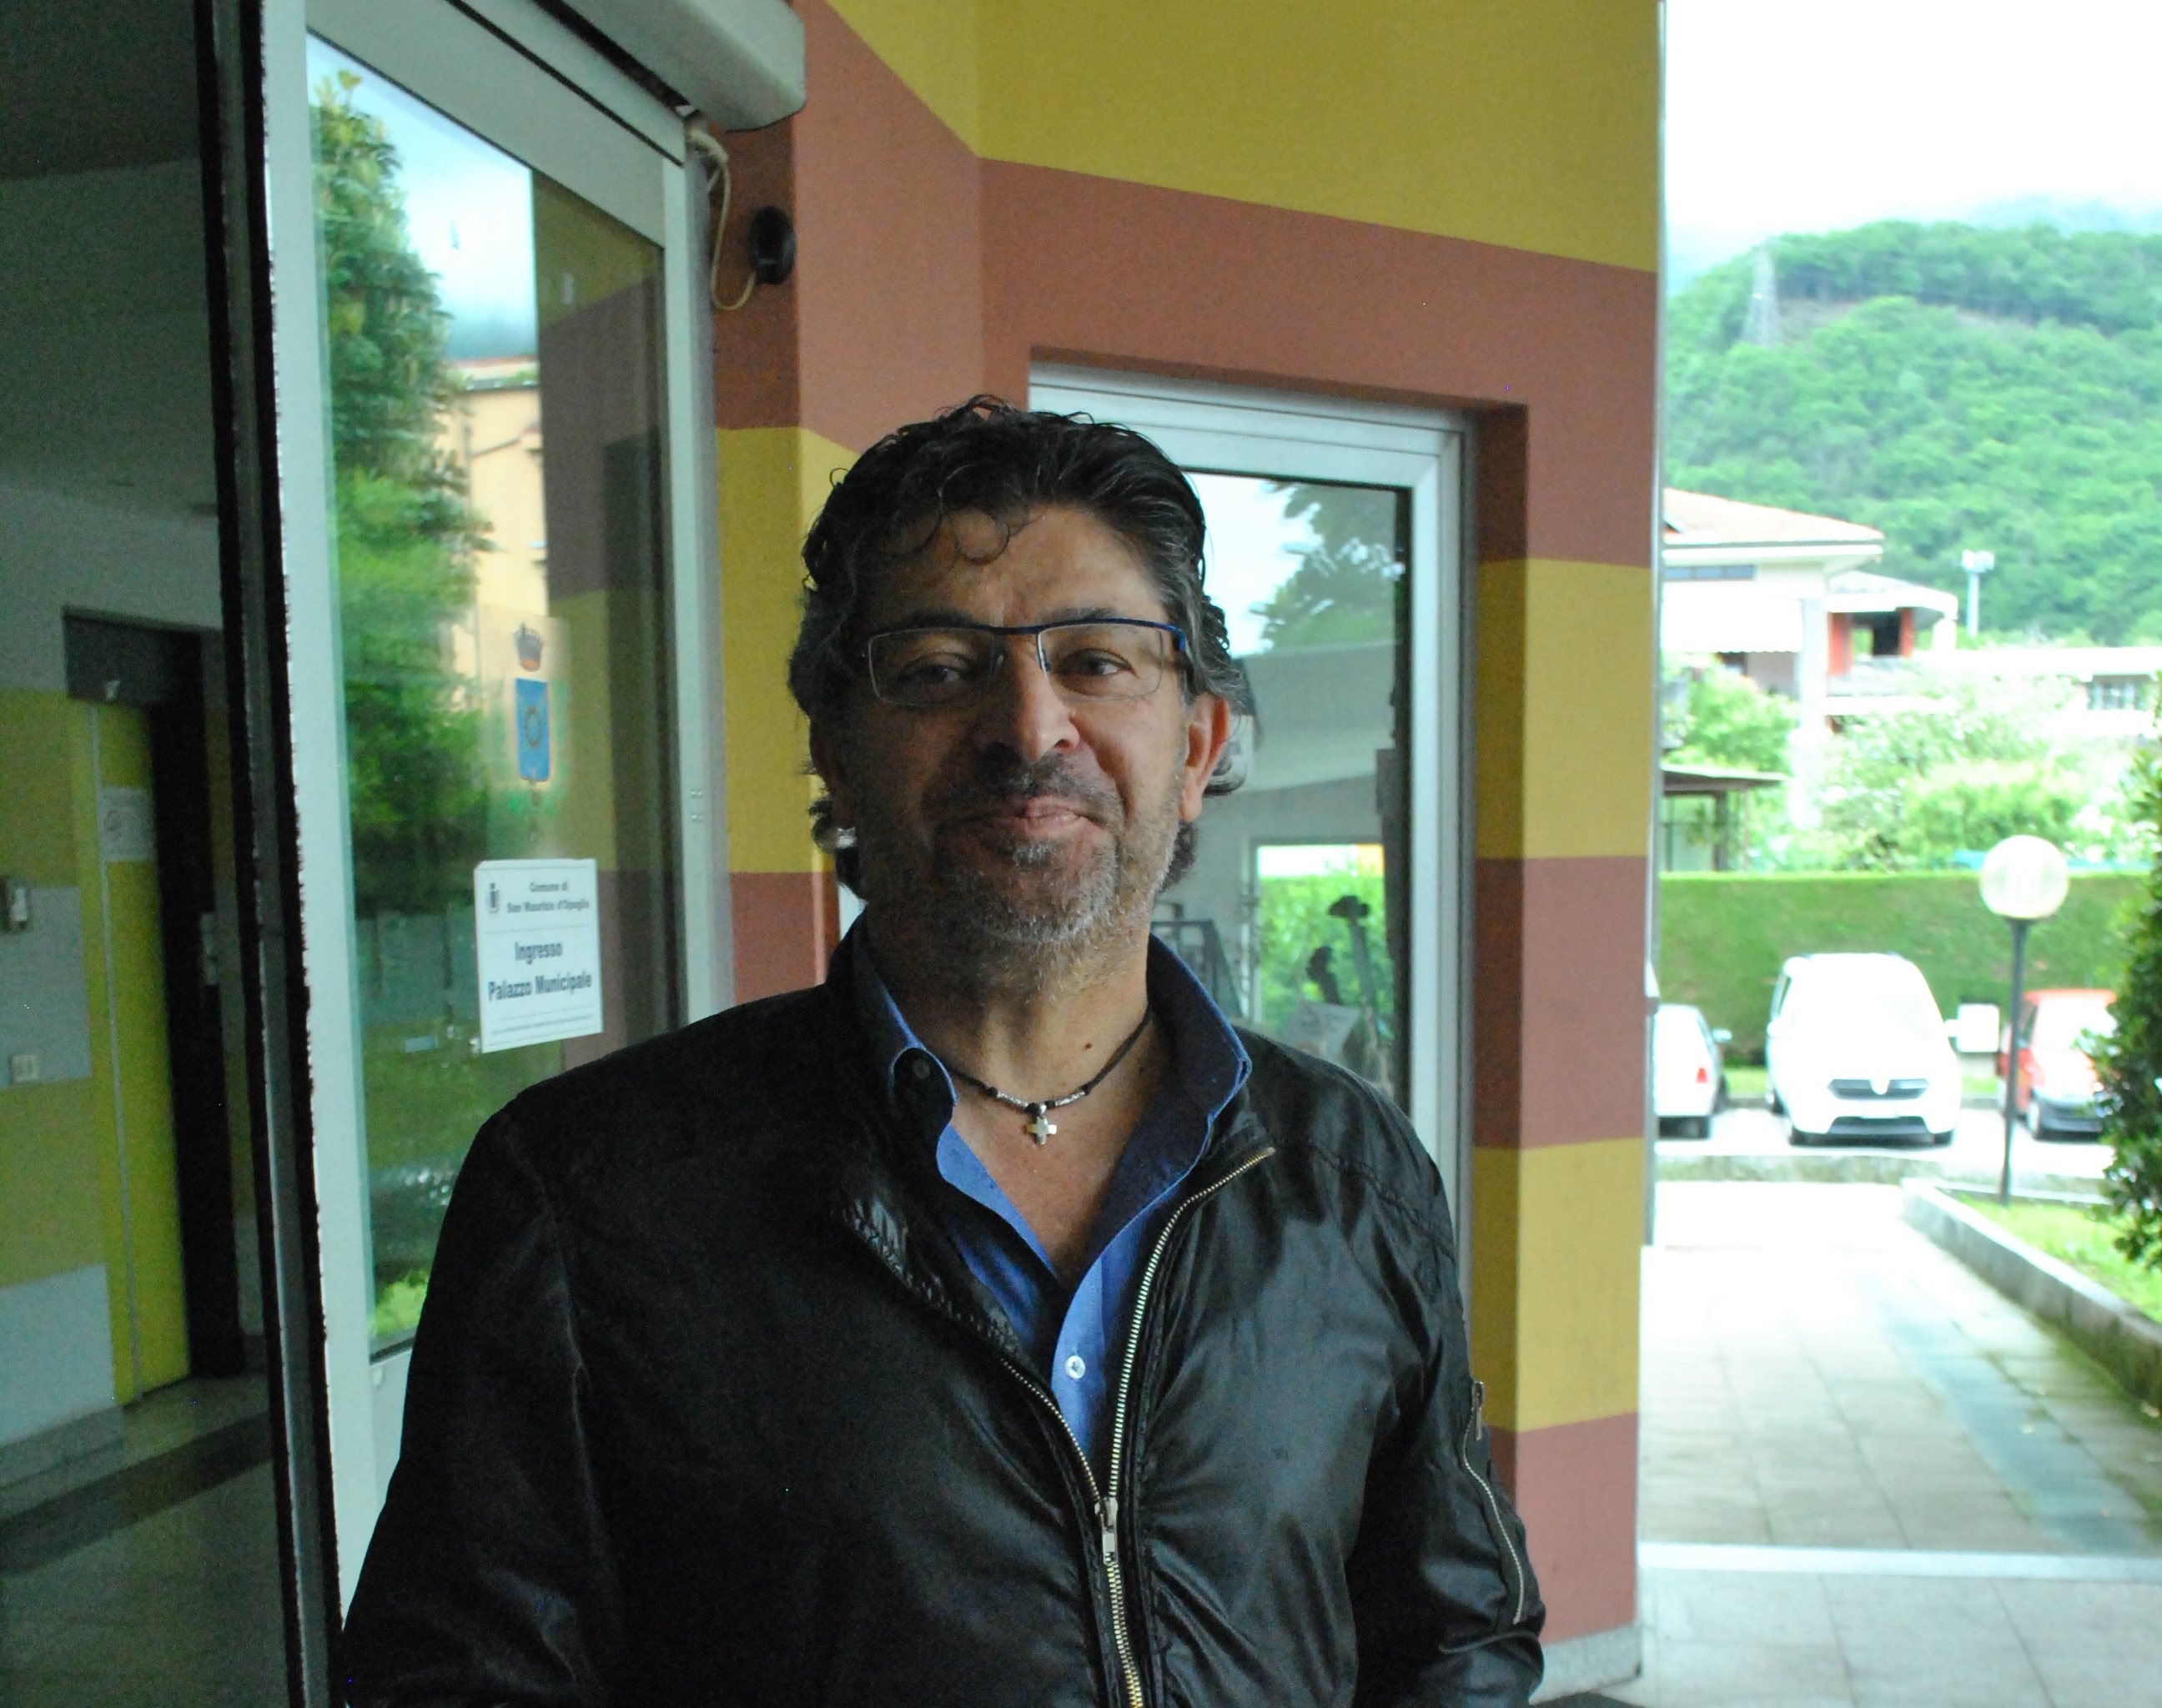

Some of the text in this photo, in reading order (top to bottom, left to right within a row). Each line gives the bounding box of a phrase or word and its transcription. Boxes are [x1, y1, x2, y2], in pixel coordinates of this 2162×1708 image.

[515, 942, 562, 965] Ingresso
[488, 969, 591, 1002] Palazzo Municipale
